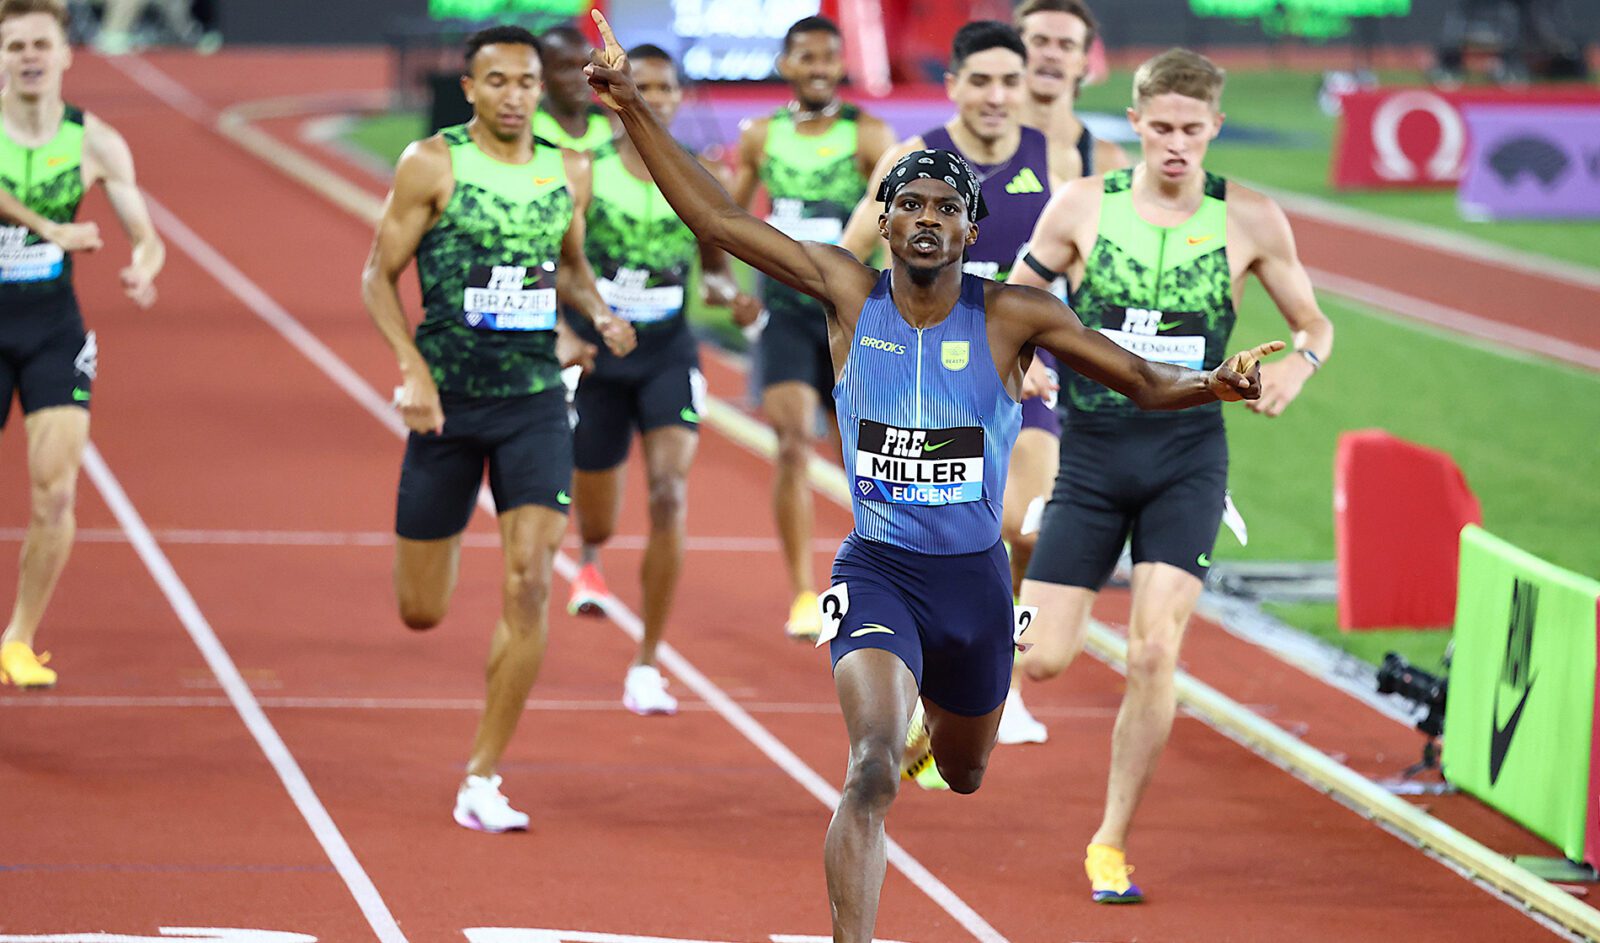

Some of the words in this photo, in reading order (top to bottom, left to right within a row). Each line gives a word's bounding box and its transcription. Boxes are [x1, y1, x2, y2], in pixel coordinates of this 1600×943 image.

[860, 335, 906, 355] BROOKS
[881, 427, 926, 458] PRE
[872, 457, 966, 483] MILLER
[892, 486, 963, 502] EUGENE
